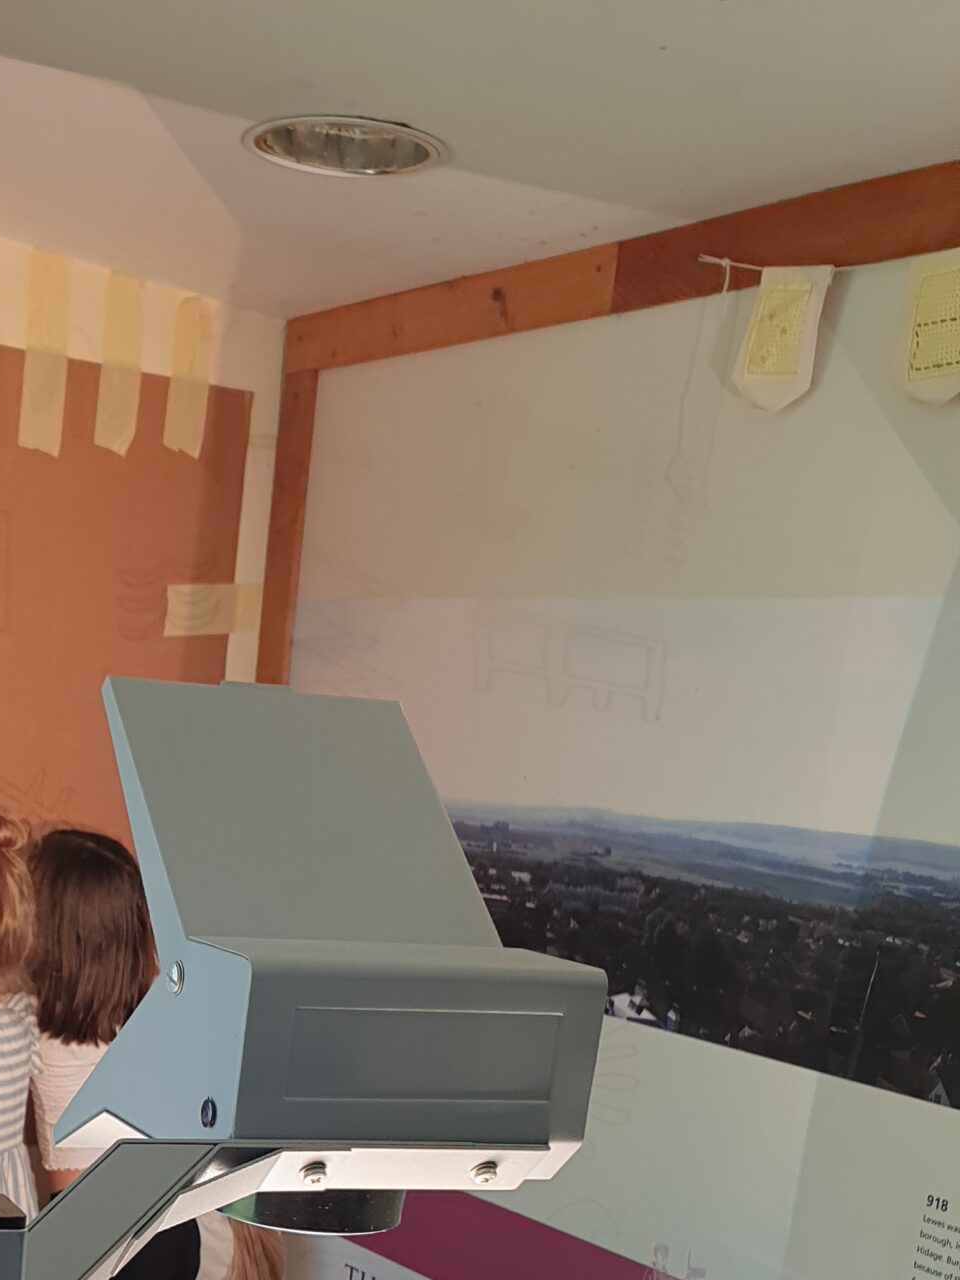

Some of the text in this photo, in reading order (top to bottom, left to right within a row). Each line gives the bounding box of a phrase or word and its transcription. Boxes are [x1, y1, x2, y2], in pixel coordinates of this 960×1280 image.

[926, 1194, 949, 1212] 918
[922, 1214, 945, 1229] Lewes
[919, 1229, 953, 1249] borough,
[913, 1261, 943, 1278] because
[944, 1273, 953, 1280] of
[946, 1255, 960, 1270] Bur
